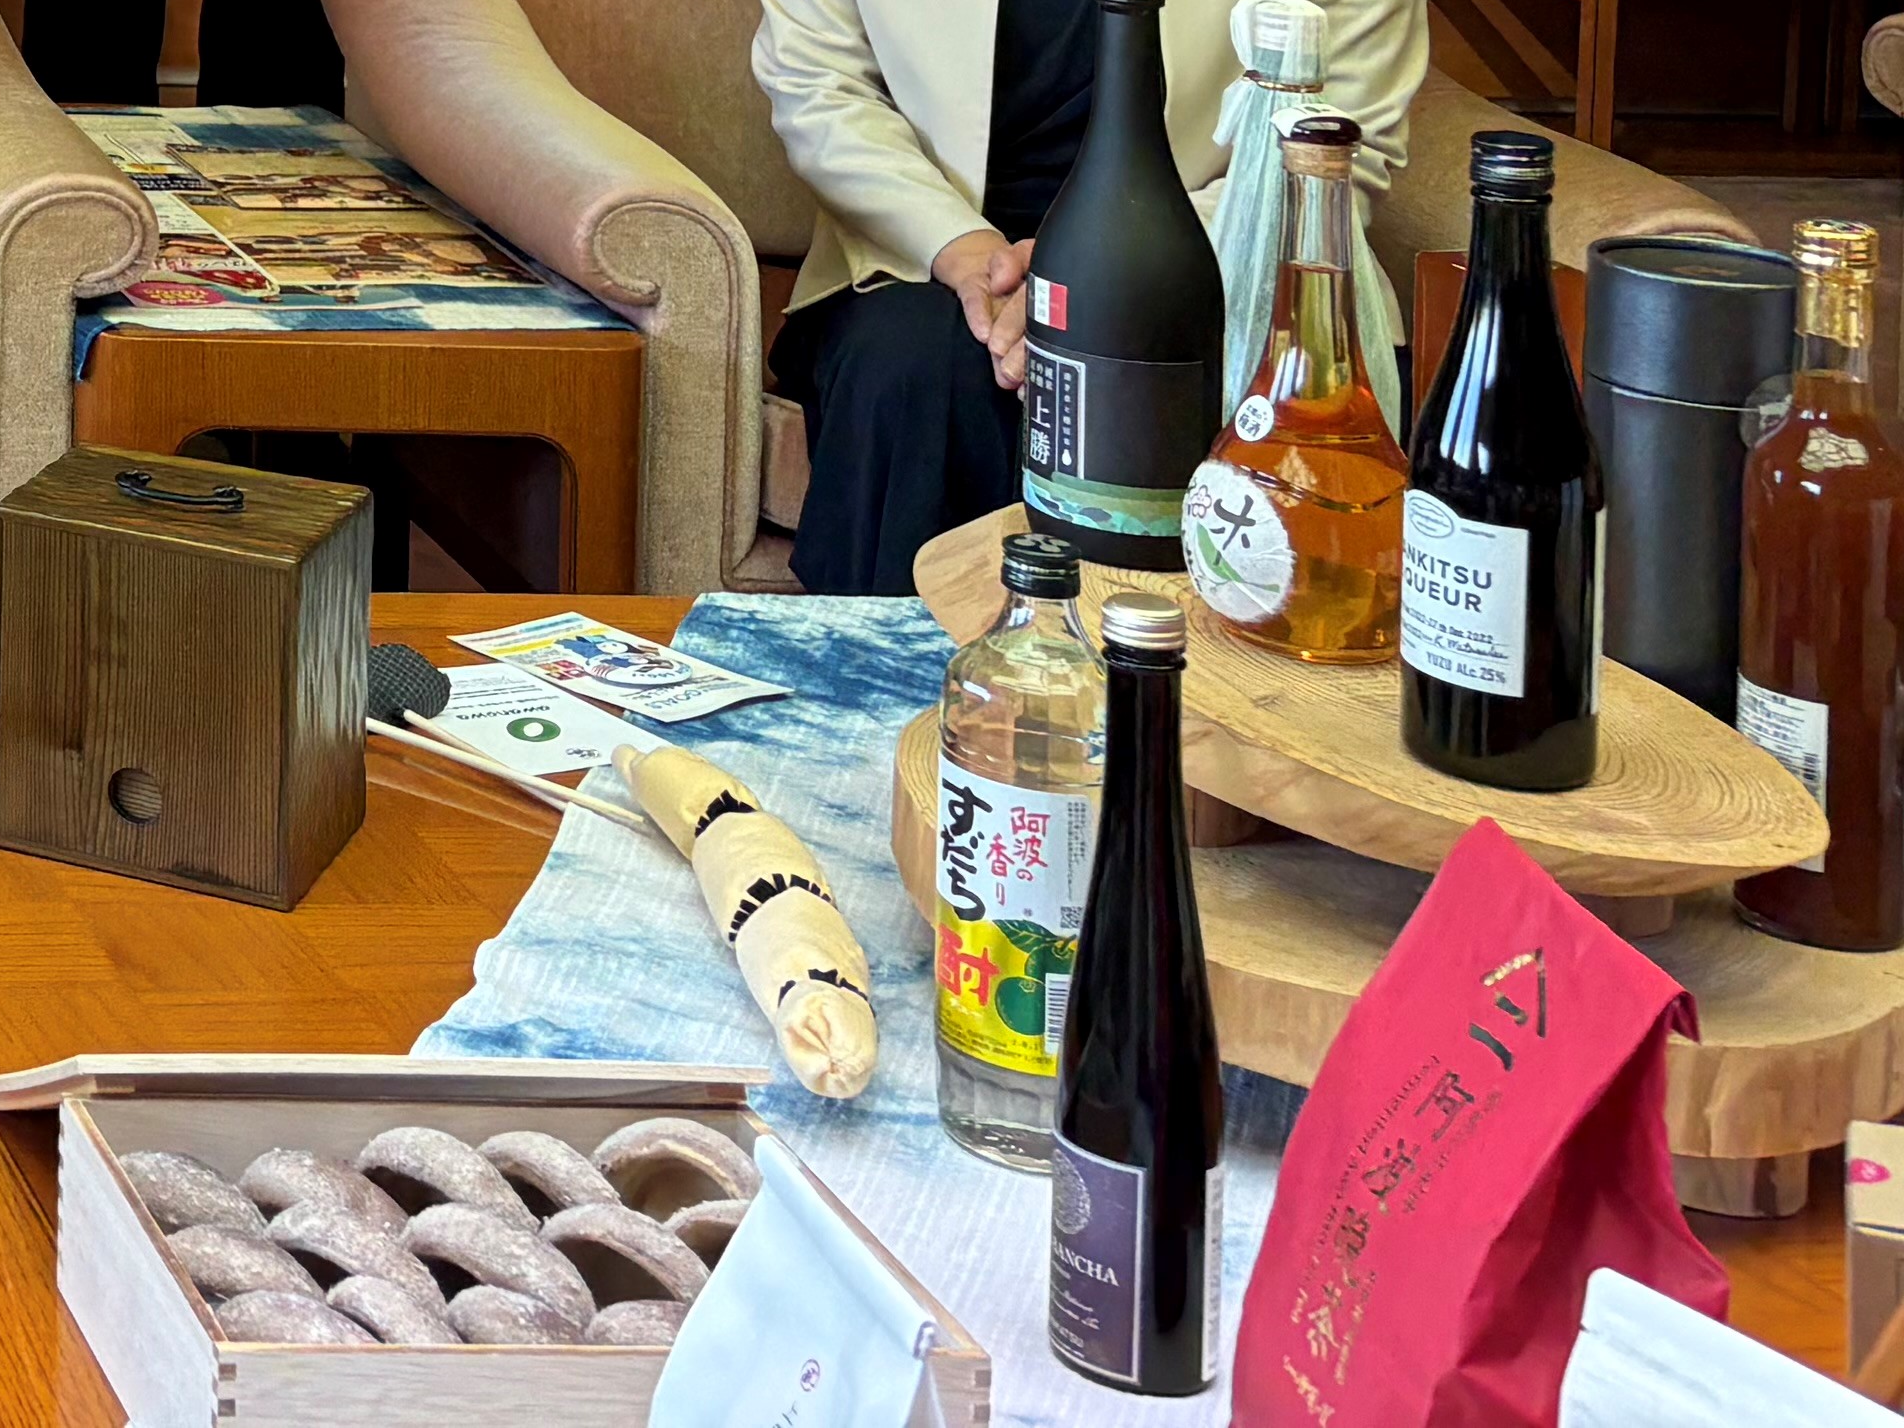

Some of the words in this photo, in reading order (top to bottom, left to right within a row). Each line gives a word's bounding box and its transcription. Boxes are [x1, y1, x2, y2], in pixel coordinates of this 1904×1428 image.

[1030, 395, 1051, 465] 上勝
[942, 777, 993, 921] すだち
[986, 832, 1014, 906] 香り
[1010, 807, 1051, 882] 阿波の
[938, 922, 1000, 1007] 酎
